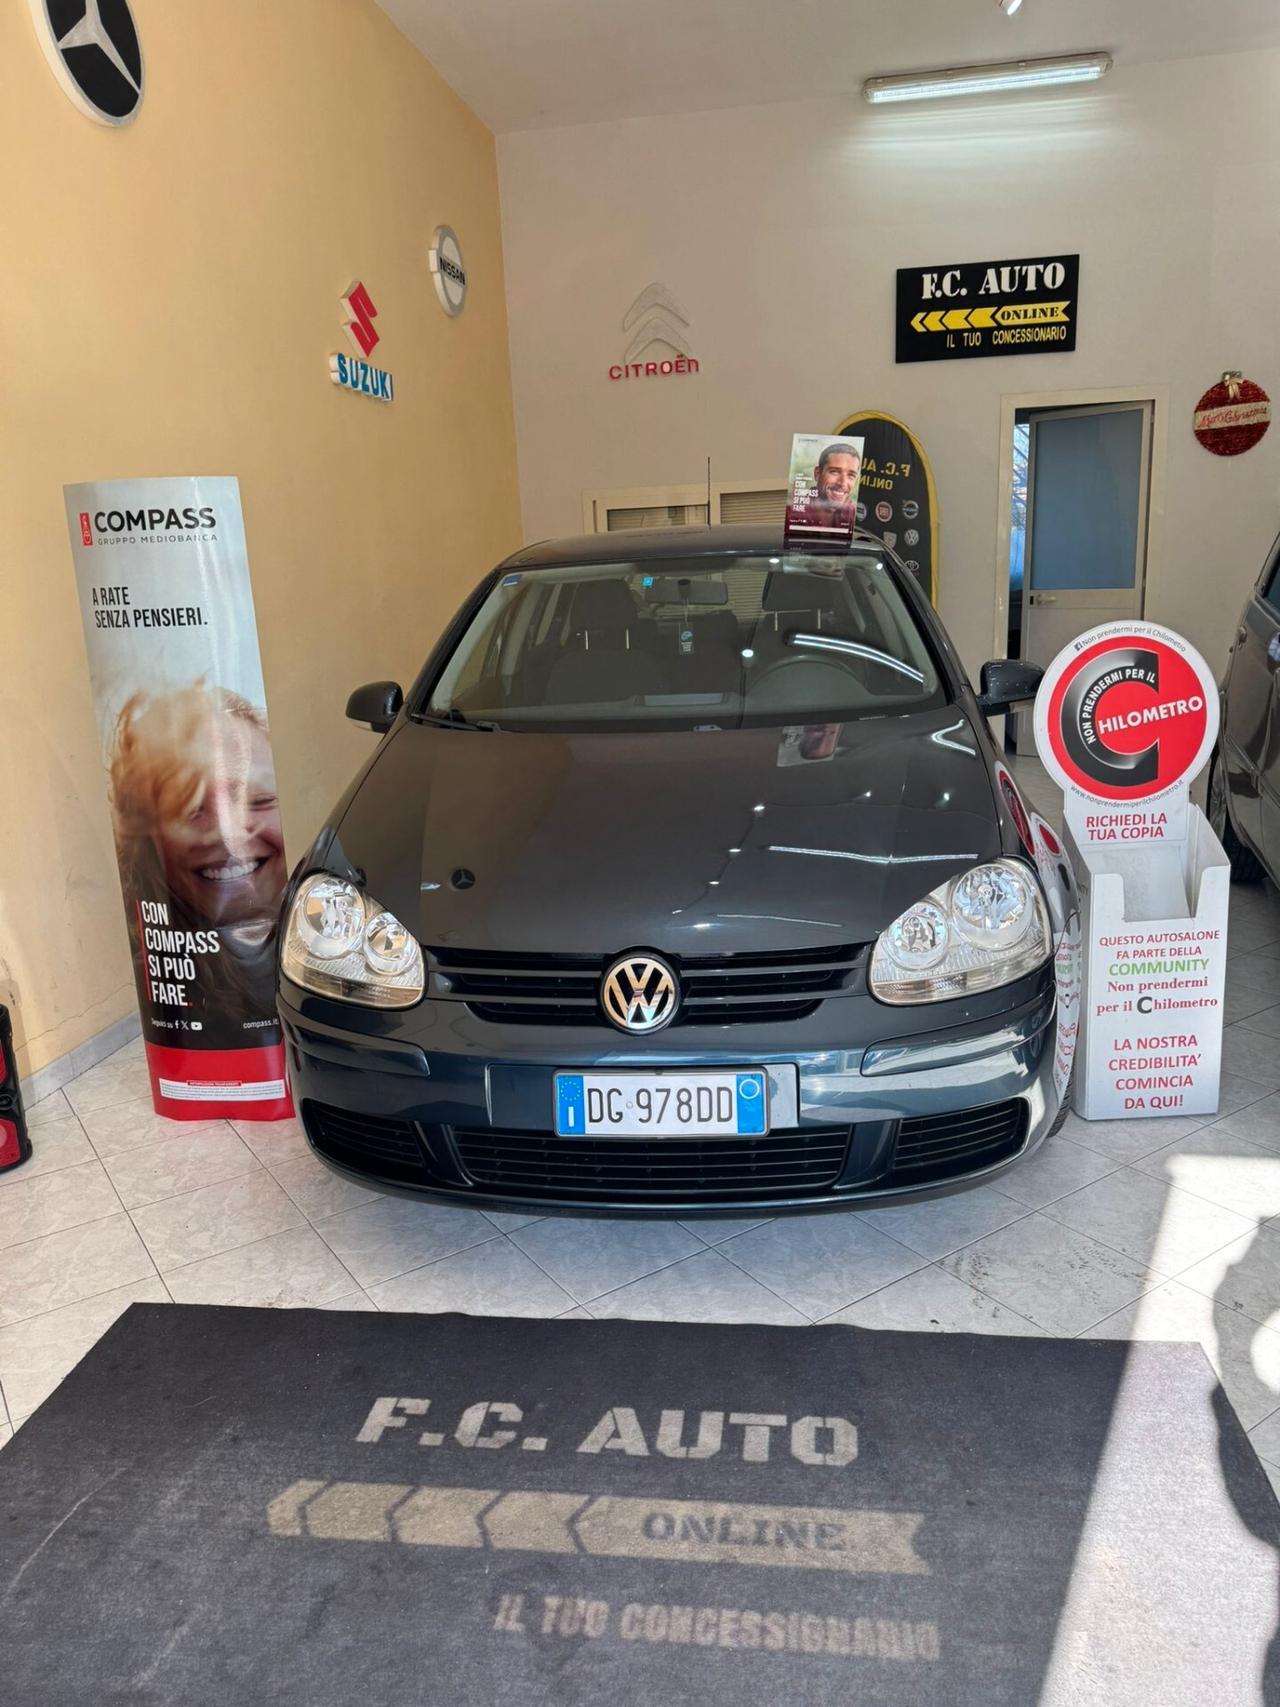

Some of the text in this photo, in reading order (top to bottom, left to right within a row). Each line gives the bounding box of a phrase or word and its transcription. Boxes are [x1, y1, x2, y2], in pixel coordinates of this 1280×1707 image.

[439, 256, 465, 286] NISSAN
[921, 262, 1066, 300] F.C. AUTO
[1001, 306, 1060, 321] ONLINE
[946, 325, 1067, 348] IL TUO CONCESSIONARIO
[337, 353, 394, 400] SUZUKI
[94, 507, 217, 533] COMPASS
[97, 533, 218, 546] GRUPPO MEDIOBANCA
[92, 586, 130, 606] A RATE
[94, 606, 208, 628] SENZA PENSIERI.
[1082, 635, 1096, 647] Non
[1097, 626, 1133, 640] prendermi
[1134, 626, 1146, 634] per
[1152, 629, 1187, 652] Chilometro
[1081, 668, 1156, 745] NON PRENDERMI PER IL
[1086, 812, 1167, 828] RICHIEDI LA
[1088, 826, 1164, 841] TUA COPIA
[141, 900, 169, 926] CON
[144, 927, 221, 954] COMPASS
[1099, 930, 1221, 947] QUESTO AUTOSALONE
[1116, 946, 1202, 960] FA PARTE DELLA
[148, 953, 196, 980] SI PUÒ
[1109, 958, 1209, 976] COMMUNITY
[1107, 976, 1209, 994] Non prendermi
[1096, 996, 1218, 1016] per il Chilometro
[1114, 1034, 1198, 1051] LA NOSTRA
[1116, 1074, 1193, 1091] COMINCIA
[1124, 1094, 1184, 1110] DA QUI!
[355, 1396, 859, 1467] F.C. AUTO
[642, 1512, 848, 1552] ONLINE
[494, 1594, 941, 1663] IL TUO CONCESSIONARIO
